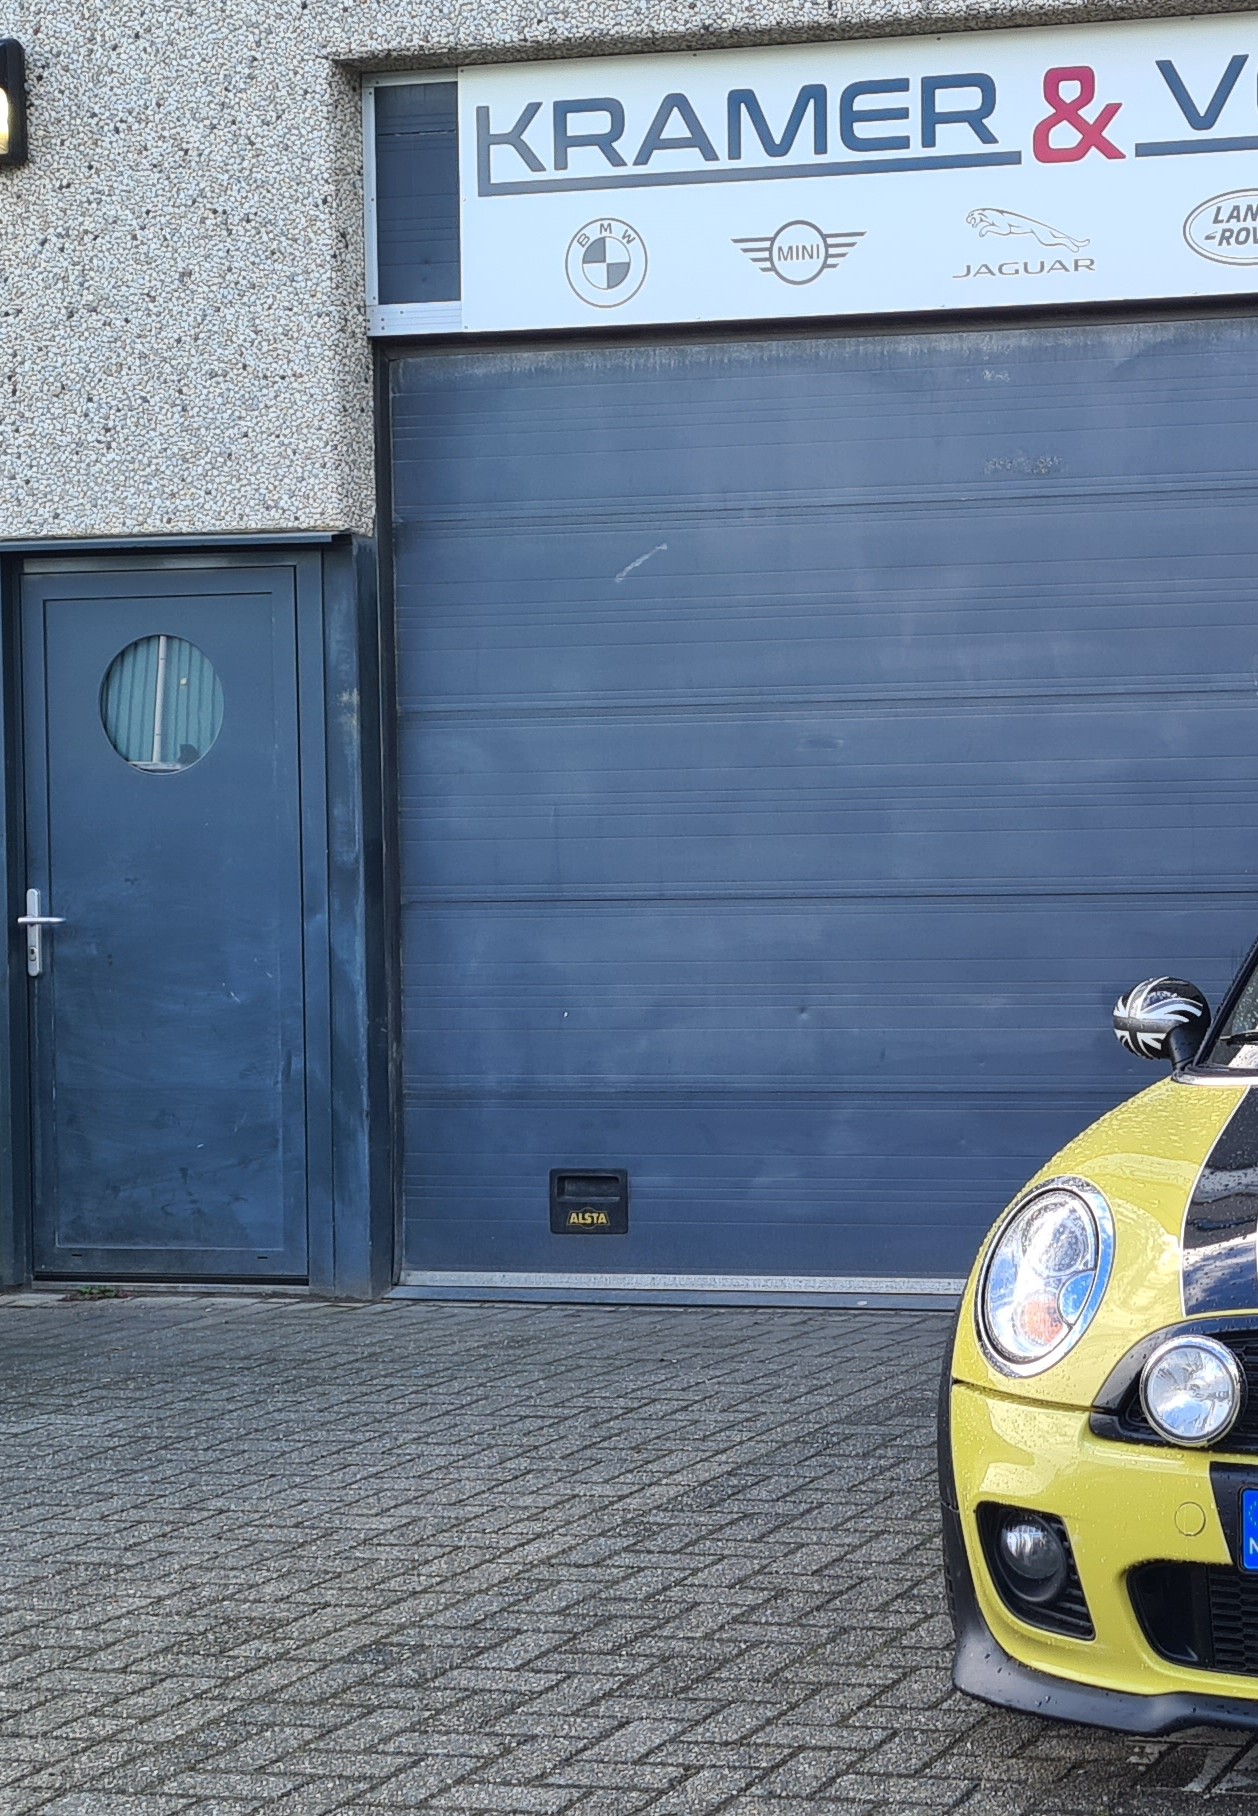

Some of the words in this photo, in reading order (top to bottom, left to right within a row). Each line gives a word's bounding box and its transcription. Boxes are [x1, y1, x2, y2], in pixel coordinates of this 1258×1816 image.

[476, 73, 1001, 197] KRAMER
[1032, 65, 1127, 164] &
[576, 222, 637, 249] BMW
[777, 243, 820, 262] MINI
[952, 258, 1096, 279] JAGUAR
[570, 1212, 607, 1224] ALSTA
